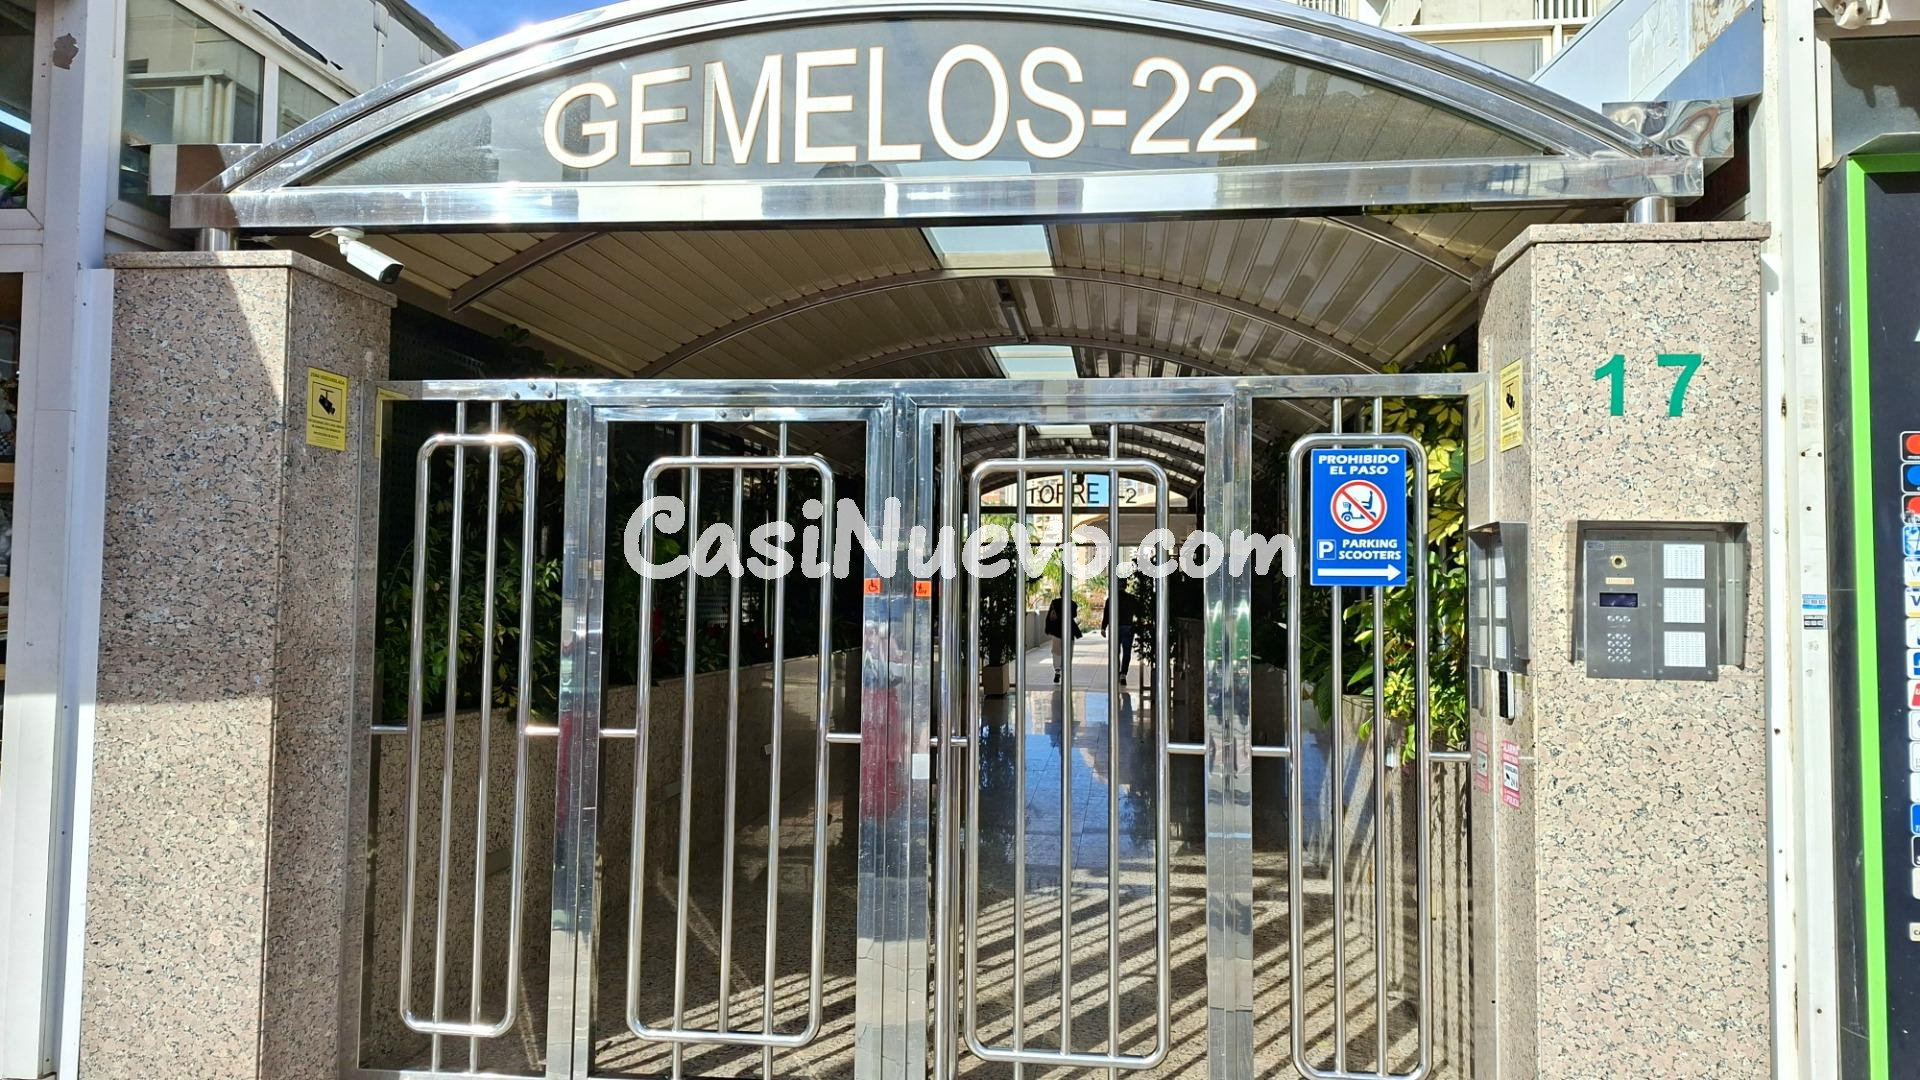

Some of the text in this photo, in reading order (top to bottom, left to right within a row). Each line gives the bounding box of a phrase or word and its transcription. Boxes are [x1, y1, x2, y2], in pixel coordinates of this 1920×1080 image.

[543, 43, 1258, 169] GEMELOS-22
[1594, 354, 1702, 417] 17
[1318, 454, 1400, 465] PROHIBIDO
[1329, 465, 1389, 475] EL PASO
[1342, 538, 1398, 549] PARKING
[1318, 541, 1334, 559] P
[1338, 549, 1402, 560] SCOOTERS
